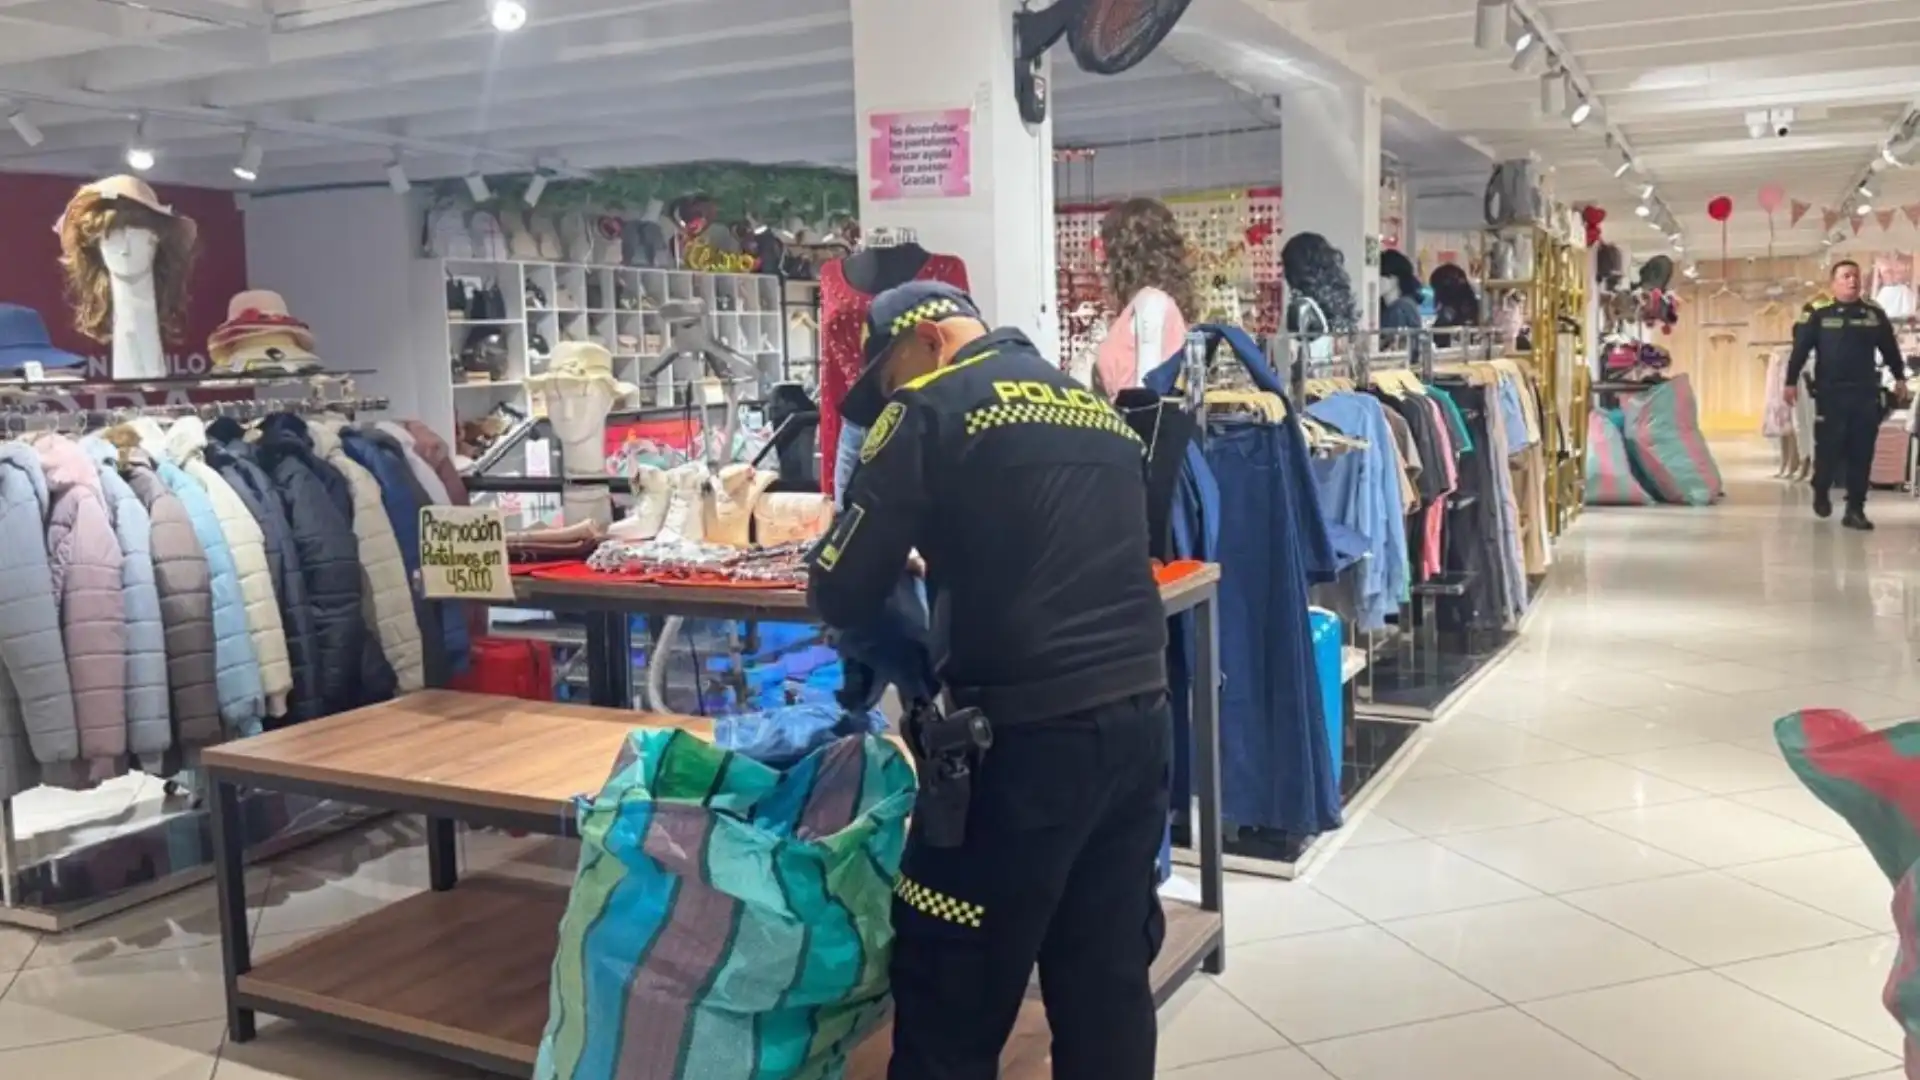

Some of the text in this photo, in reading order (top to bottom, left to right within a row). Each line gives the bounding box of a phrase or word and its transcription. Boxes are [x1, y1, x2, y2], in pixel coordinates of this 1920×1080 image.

[889, 124, 903, 136] No
[902, 175, 936, 186] Gracias
[422, 509, 502, 543] Promoción
